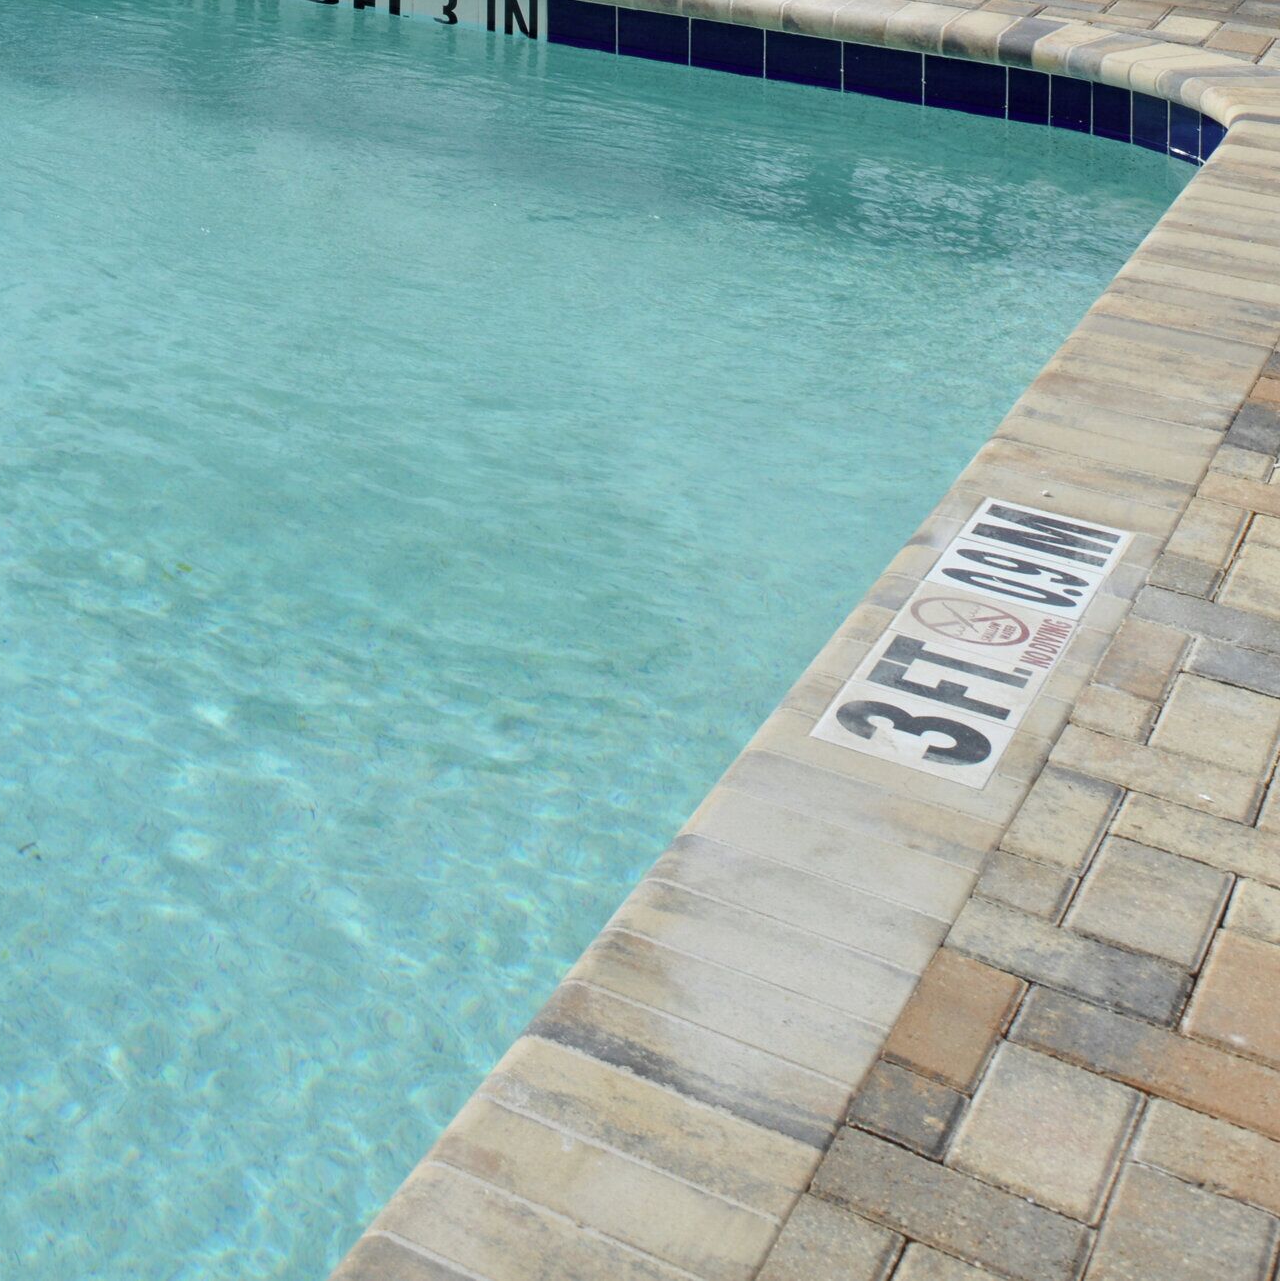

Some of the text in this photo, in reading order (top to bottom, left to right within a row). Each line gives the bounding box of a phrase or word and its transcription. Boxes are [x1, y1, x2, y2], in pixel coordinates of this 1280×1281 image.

[970, 503, 1122, 568] M
[941, 548, 1090, 608] 0.9
[1019, 618, 1073, 669] NO DIVING
[836, 699, 992, 767] 3
